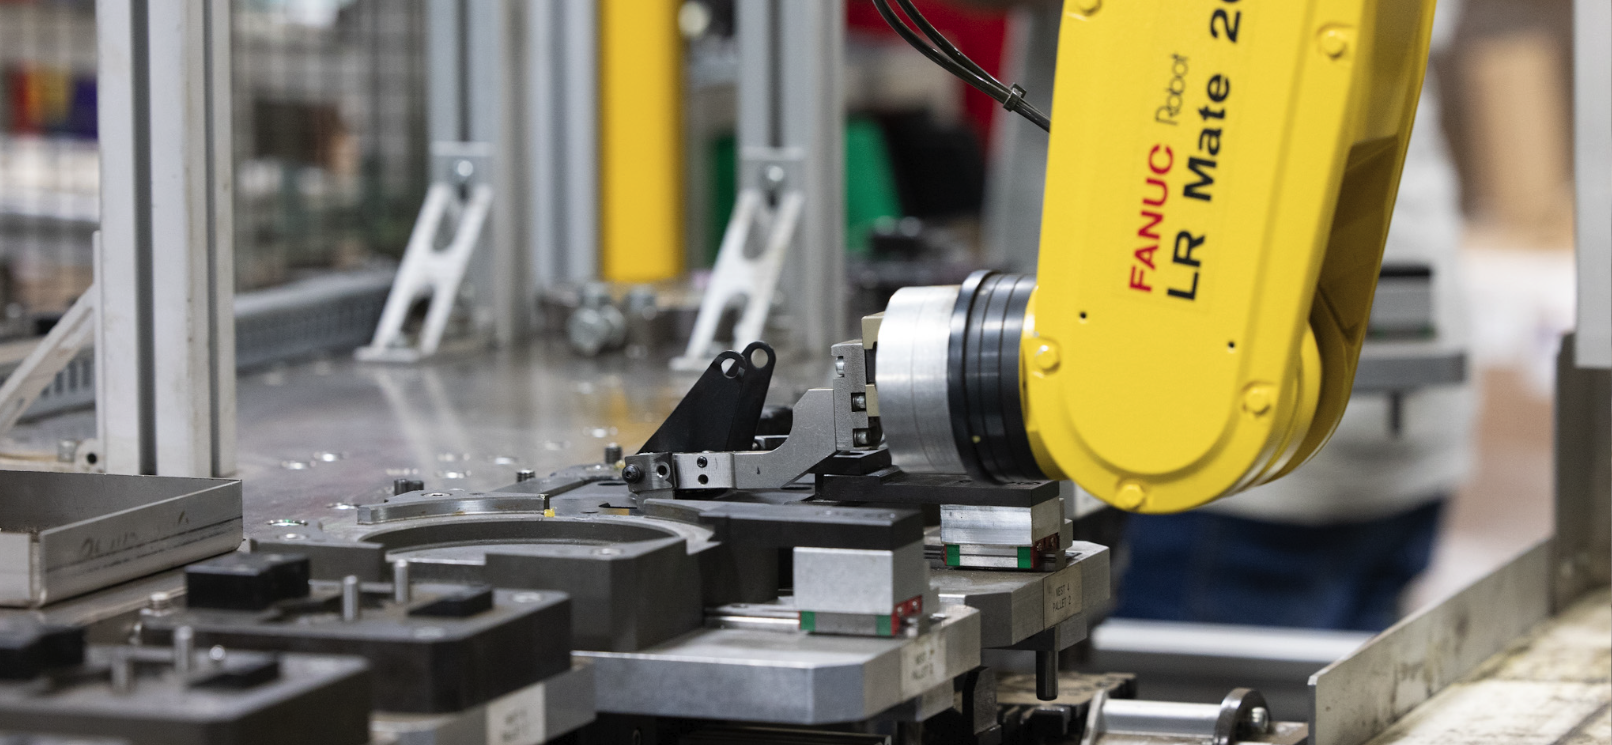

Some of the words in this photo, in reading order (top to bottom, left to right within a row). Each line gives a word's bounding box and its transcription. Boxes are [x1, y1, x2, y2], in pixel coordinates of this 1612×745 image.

[1210, 0, 1242, 43] 2
[1129, 144, 1174, 292] FANUC
[1155, 53, 1189, 125] Robot
[1183, 74, 1231, 201] Mate
[1167, 230, 1205, 301] LR
[1052, 597, 1067, 612] PALLET
